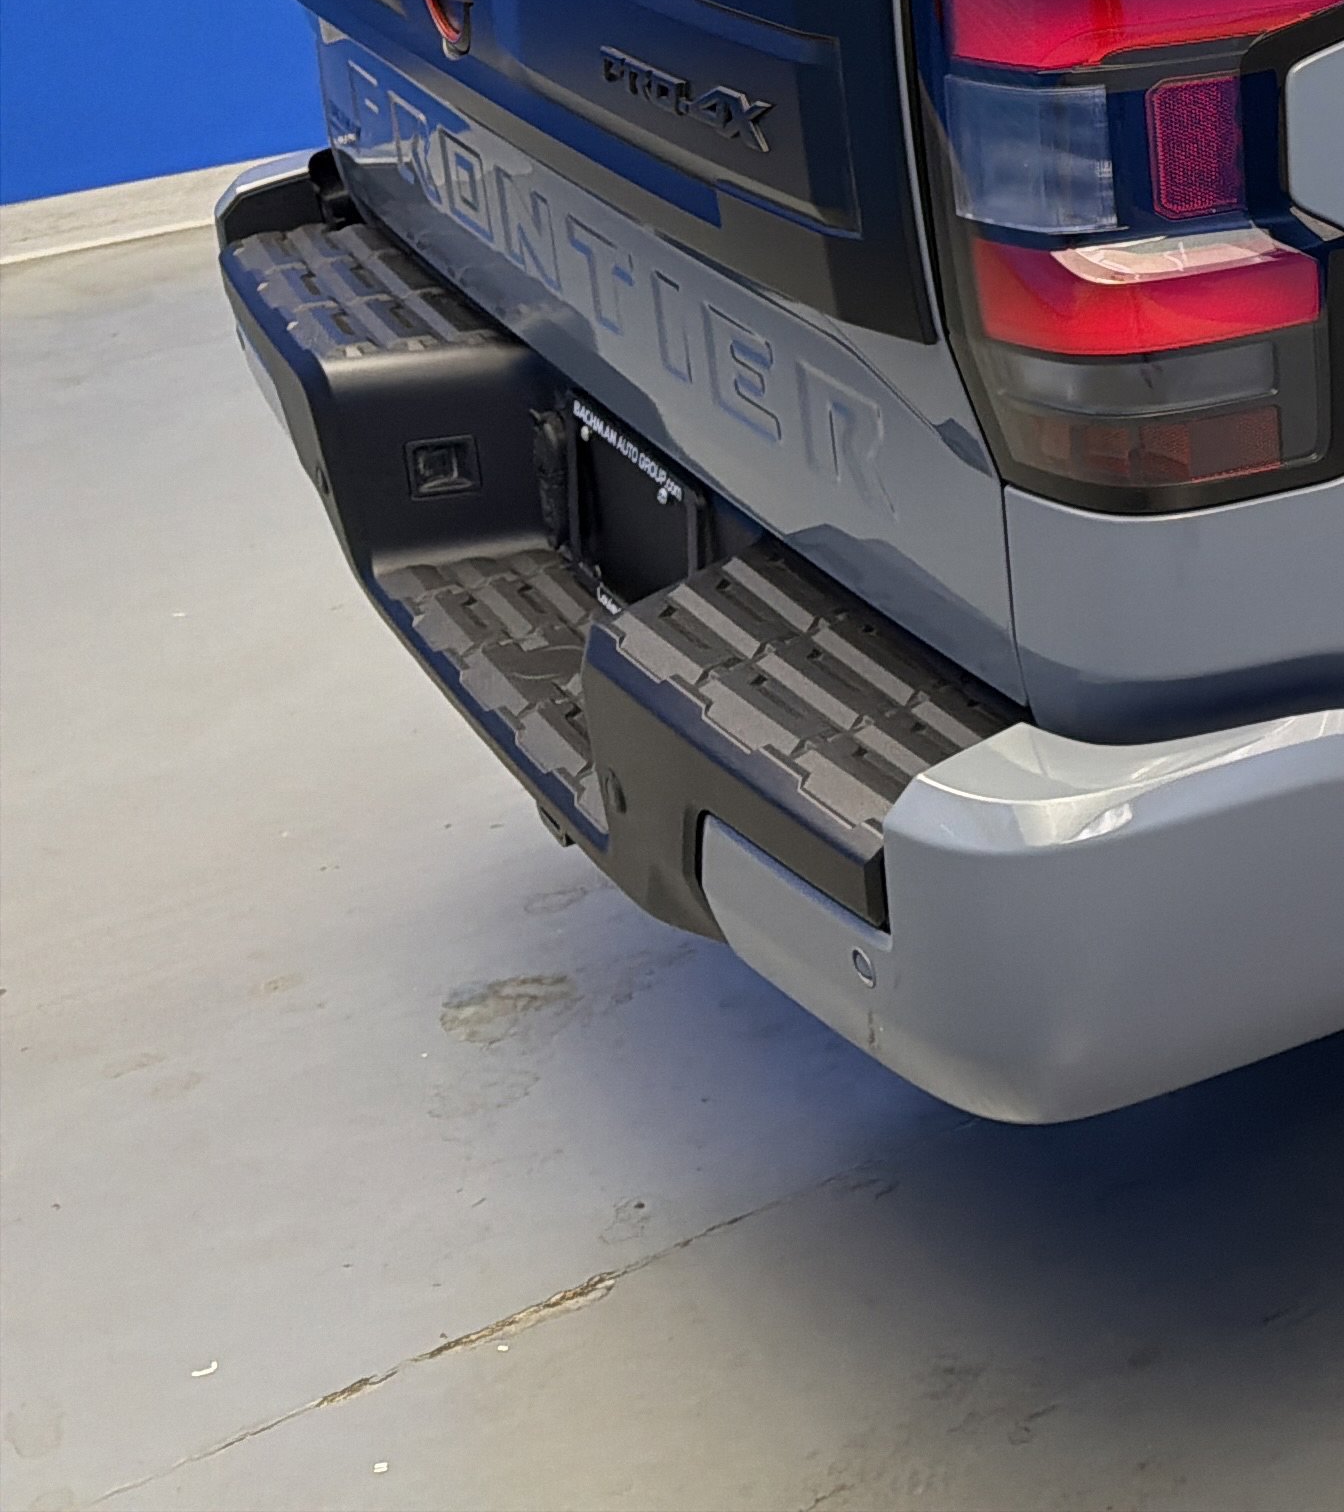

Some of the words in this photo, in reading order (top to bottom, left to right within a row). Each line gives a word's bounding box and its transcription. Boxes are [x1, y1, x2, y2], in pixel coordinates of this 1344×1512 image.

[348, 58, 897, 517] FRONTIER
[572, 399, 618, 448] BACHMAN
[616, 435, 640, 464] AUTO
